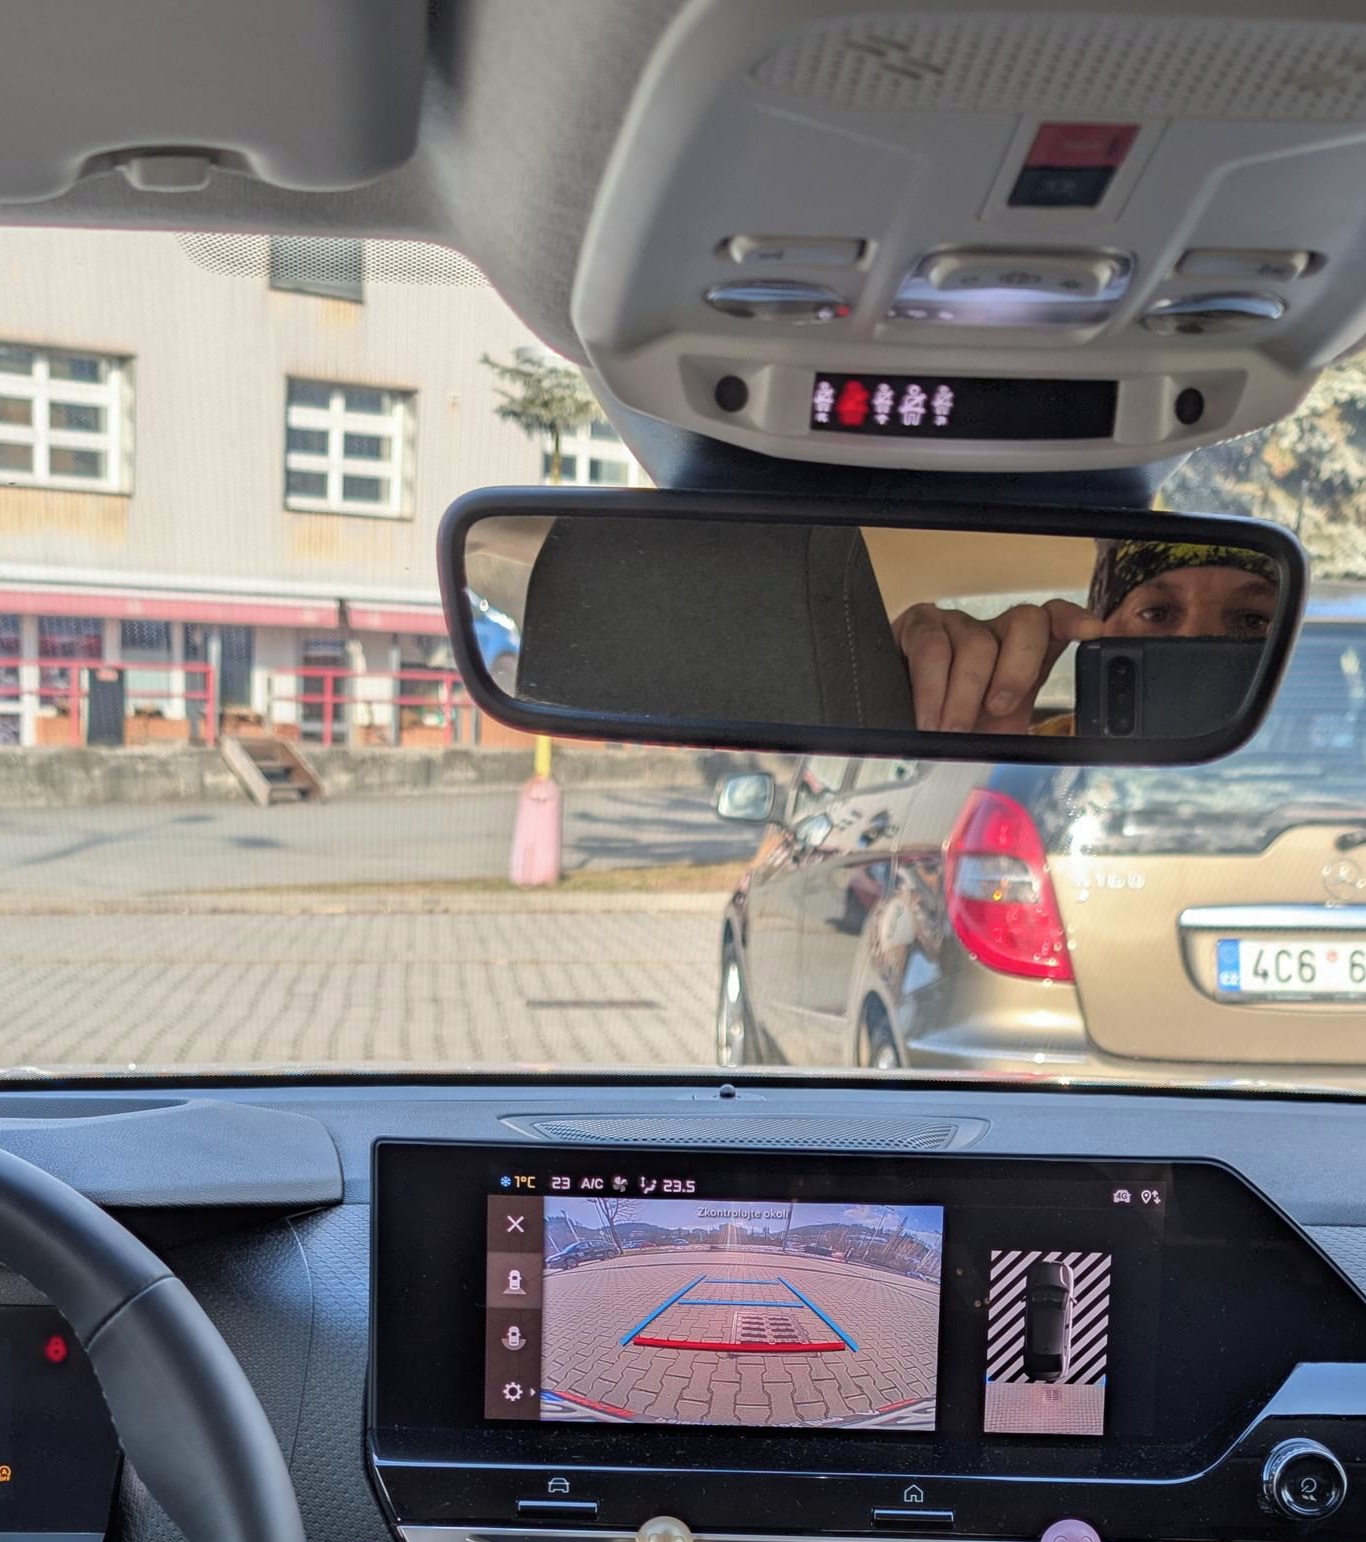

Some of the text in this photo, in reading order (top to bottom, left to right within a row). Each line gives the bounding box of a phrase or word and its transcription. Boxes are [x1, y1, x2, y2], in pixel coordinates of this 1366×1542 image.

[1252, 948, 1317, 984] 4C6
[551, 1176, 571, 1190] 23
[580, 1177, 604, 1190] A/C
[662, 1179, 696, 1193] 23.5
[698, 1206, 763, 1220] Zkontrolujte
